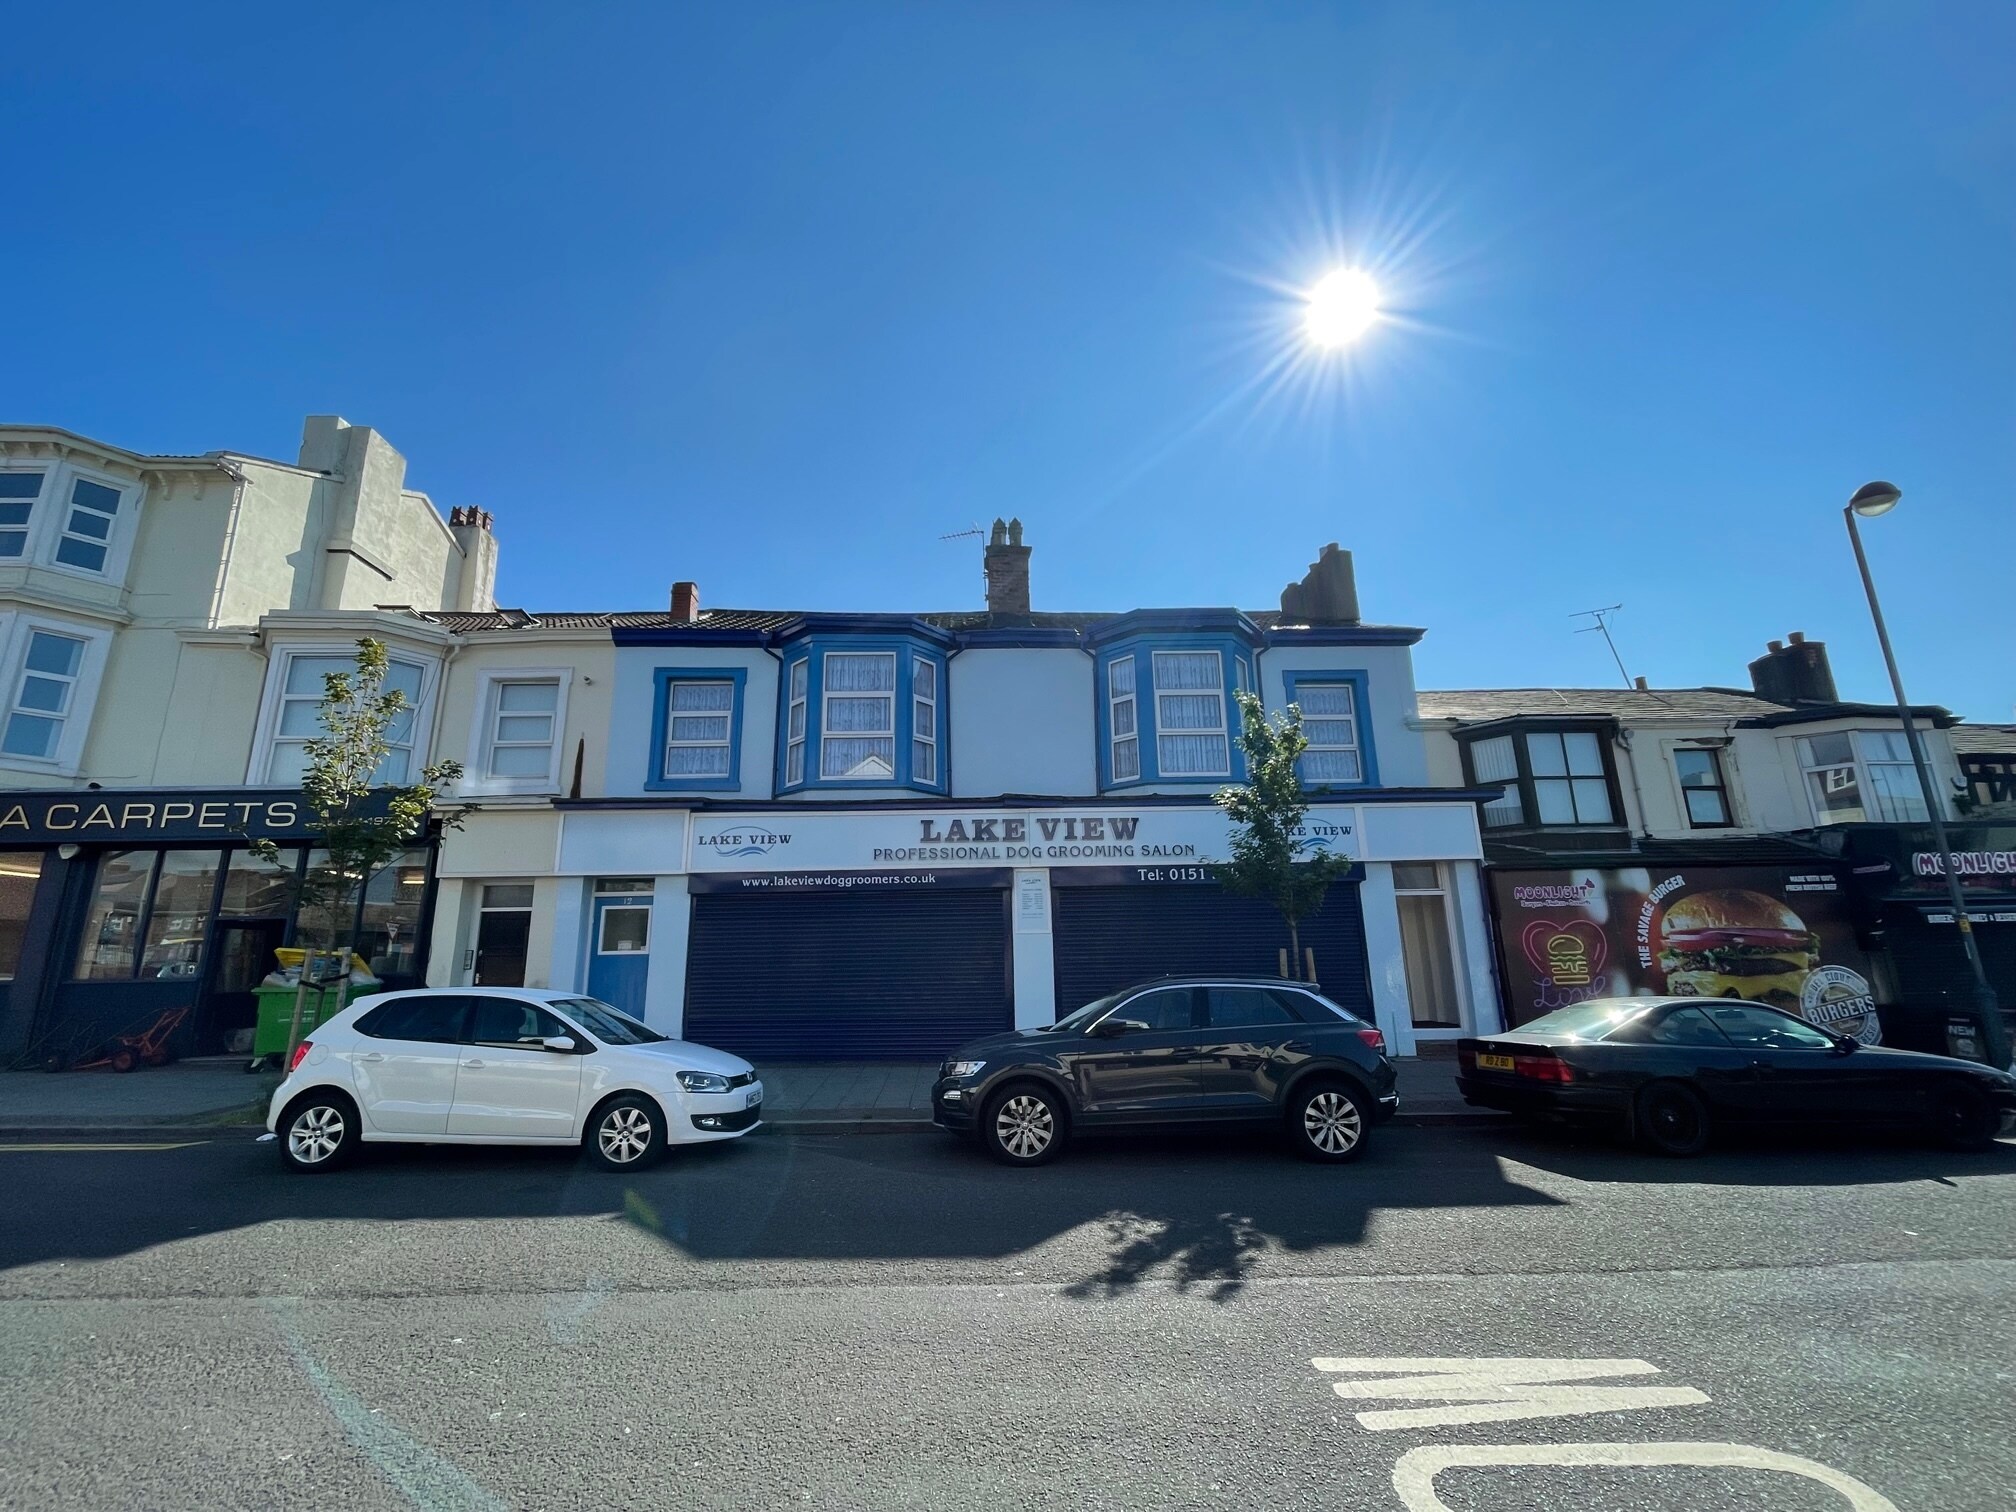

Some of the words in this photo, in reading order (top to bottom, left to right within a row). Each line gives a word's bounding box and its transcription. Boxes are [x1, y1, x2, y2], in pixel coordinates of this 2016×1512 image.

[45, 802, 298, 829] CARPETS
[920, 818, 1026, 843] LAKE
[1036, 817, 1140, 841] VIEW
[1312, 826, 1352, 836] VIEW
[698, 835, 742, 845] LAKE
[749, 834, 792, 845] VIEW
[873, 847, 1000, 860] PROFESSIONAL
[1006, 846, 1042, 859] DOG
[1047, 845, 1134, 859] GROOMING
[1141, 844, 1195, 857] SALON
[742, 873, 936, 888] www.lakeviewdoggroomers.co.uk
[1138, 869, 1164, 881] Tel:
[1169, 868, 1205, 881] 0151
[1514, 885, 1588, 900] MOONLIGHT
[1648, 874, 1686, 905] BURGER
[1637, 901, 1655, 944] SAVAGE
[1638, 945, 1653, 969] THE
[1809, 995, 1876, 1025] BURGERS
[1948, 1025, 1976, 1036] NEW
